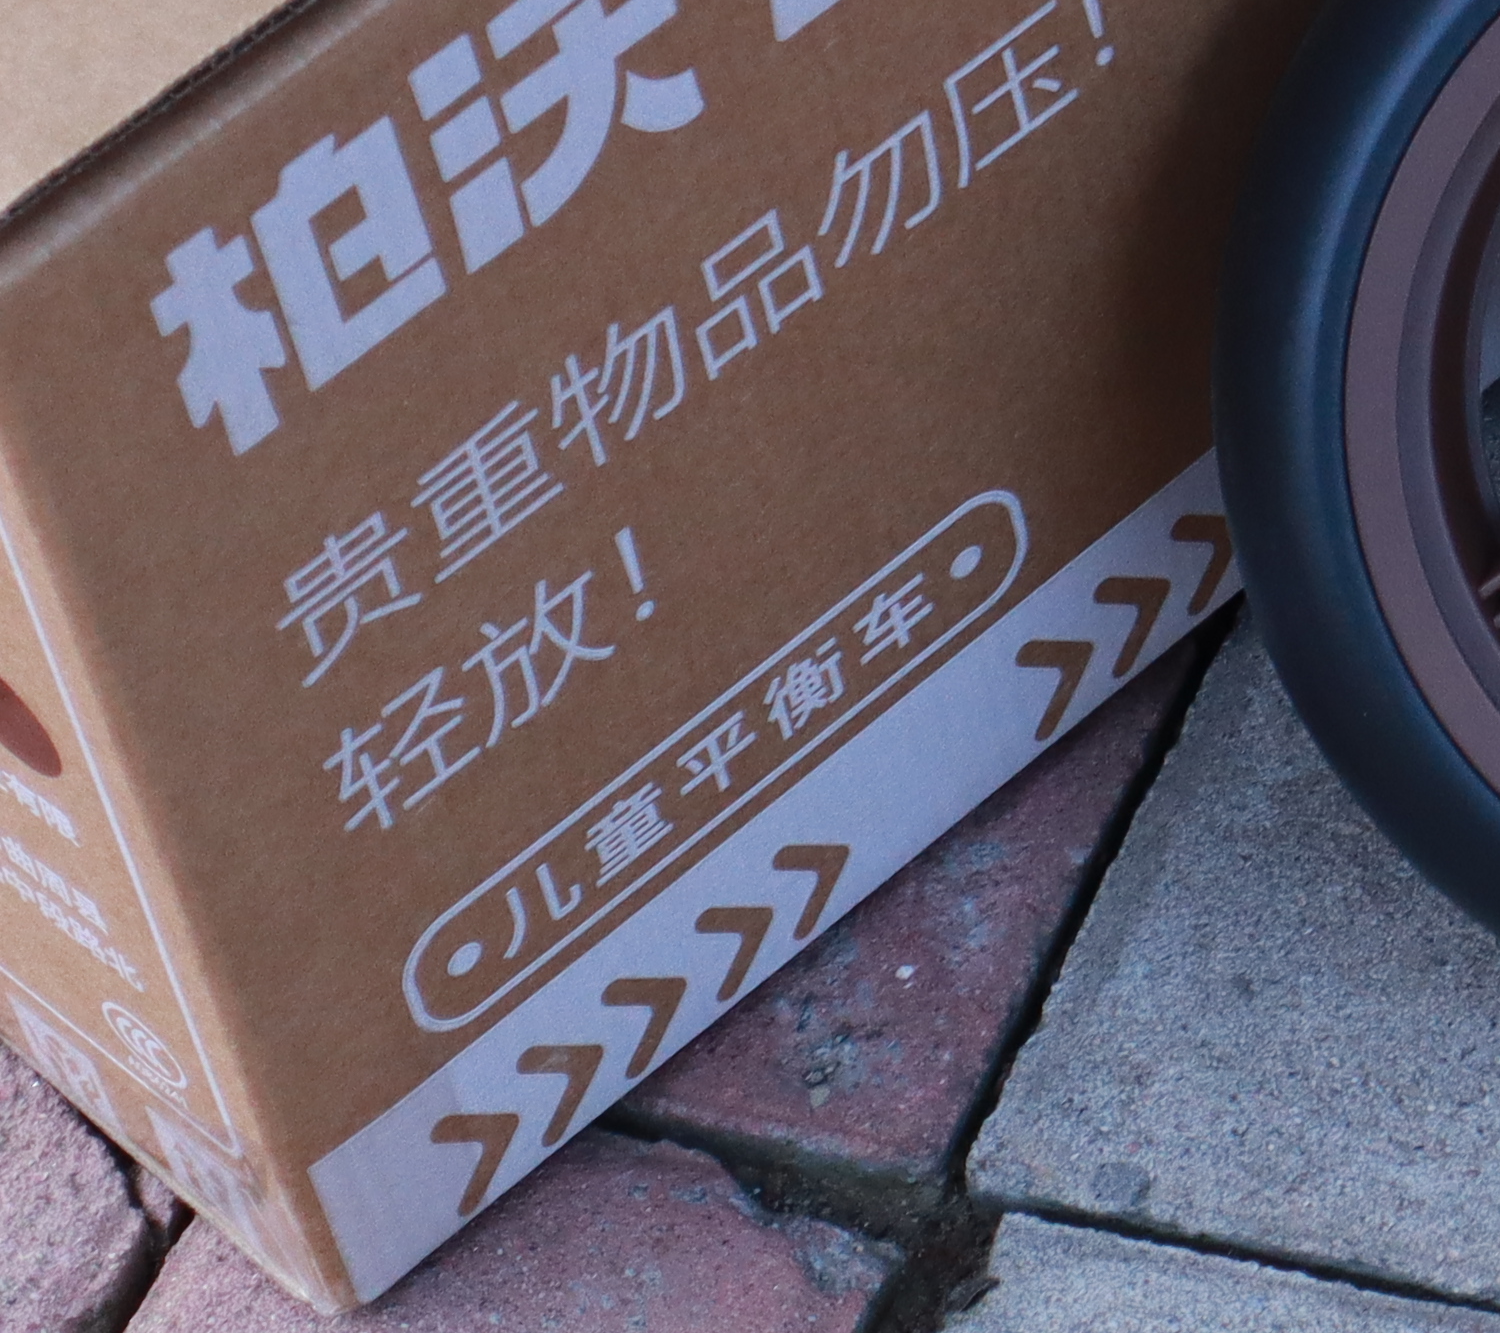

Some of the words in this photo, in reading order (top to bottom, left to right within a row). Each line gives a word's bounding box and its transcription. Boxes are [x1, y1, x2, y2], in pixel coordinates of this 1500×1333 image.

[503, 569, 929, 958] 儿童平衡车
